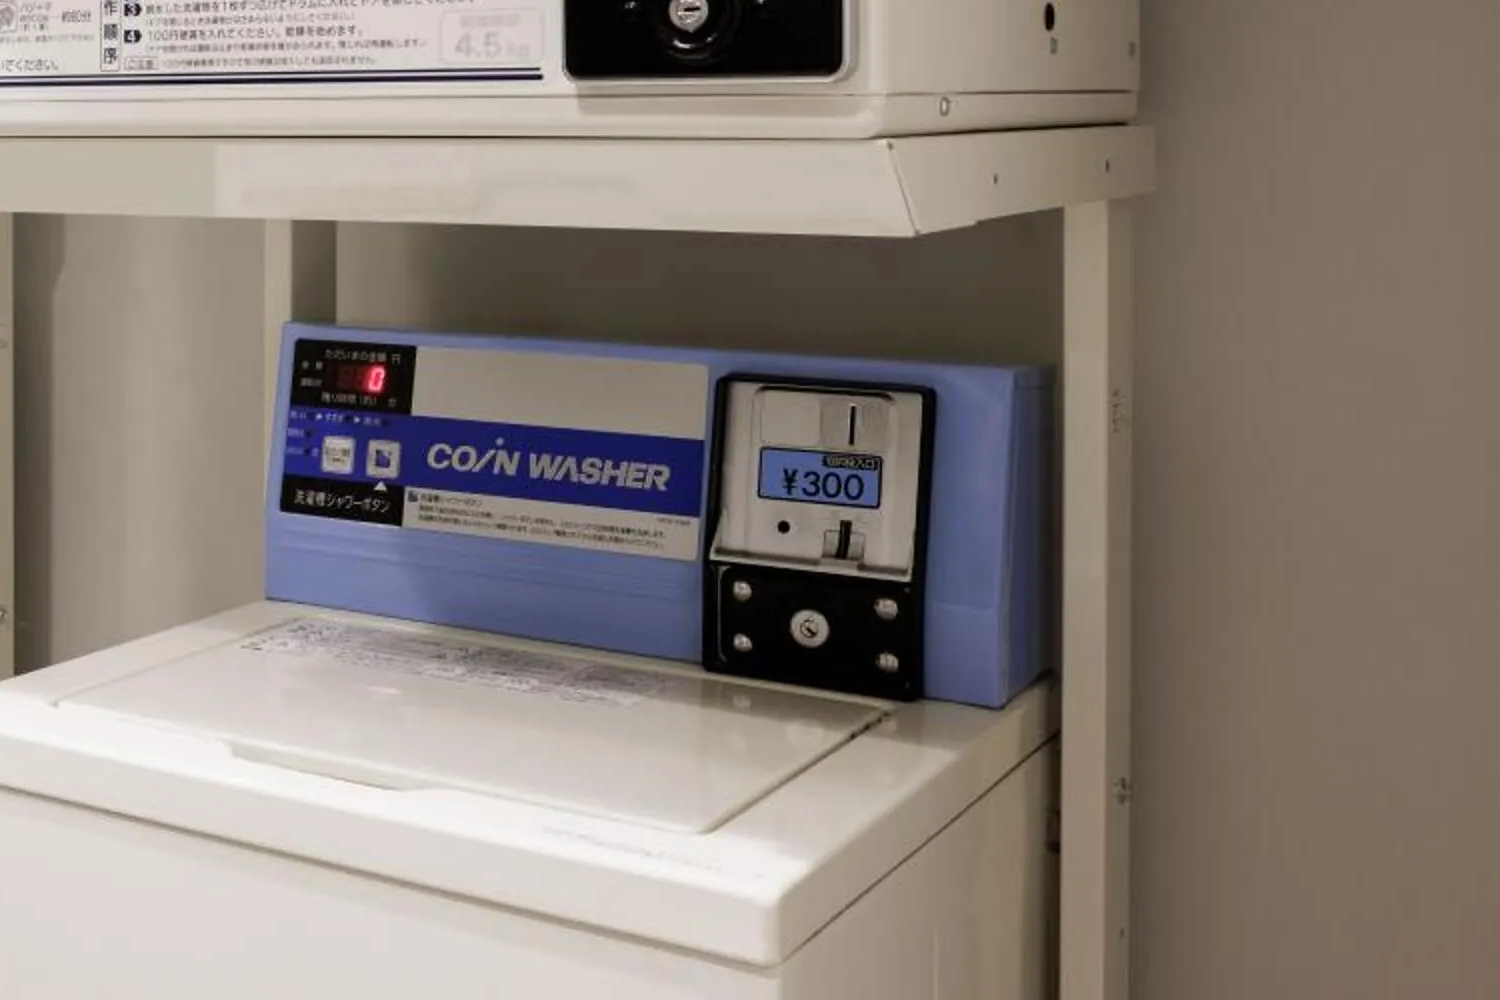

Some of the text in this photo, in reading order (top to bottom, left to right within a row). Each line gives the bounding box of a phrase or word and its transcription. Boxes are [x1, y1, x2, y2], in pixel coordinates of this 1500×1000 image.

[368, 365, 385, 392] 0
[529, 453, 671, 491] WASHER
[782, 468, 865, 500] ¥300
